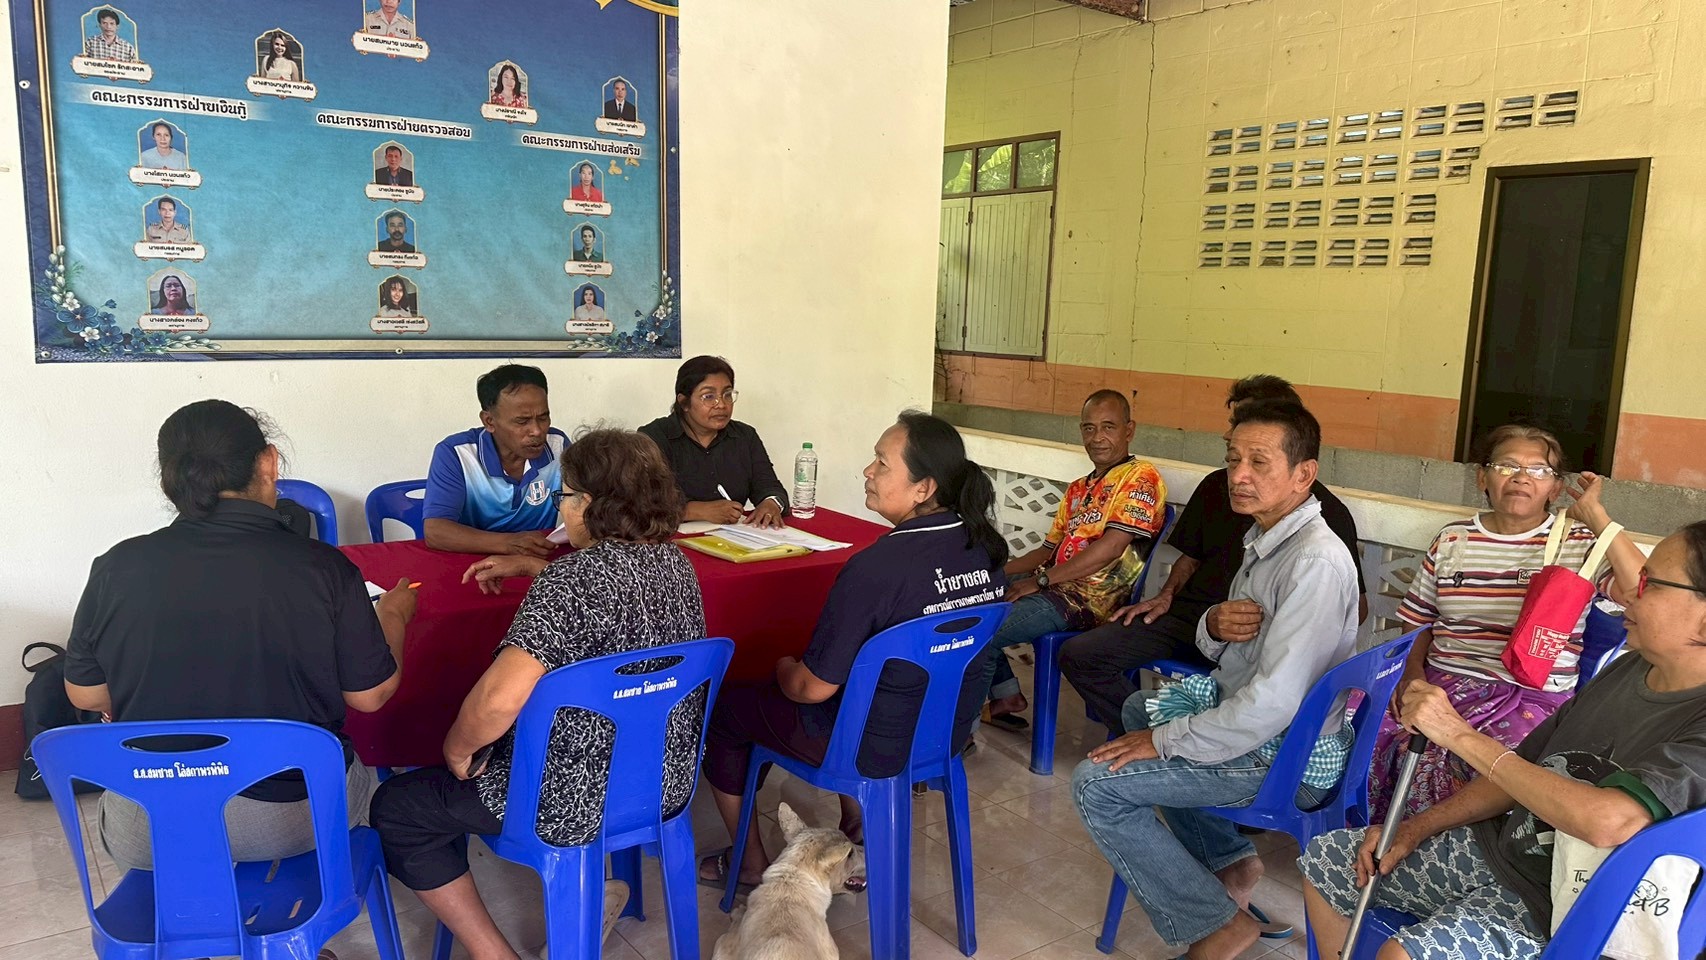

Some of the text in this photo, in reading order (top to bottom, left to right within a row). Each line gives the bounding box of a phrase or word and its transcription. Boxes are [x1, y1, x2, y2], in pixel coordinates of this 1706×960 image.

[92, 91, 246, 119] คณะกรรมการฝ่ายเงินกู้
[317, 113, 470, 137] คณะกรรมการฝ่ายตรวจสอบ
[522, 135, 640, 156] คณะกรรมการฝ่ายส่งเสริม
[934, 567, 991, 594] น้ำยางสด
